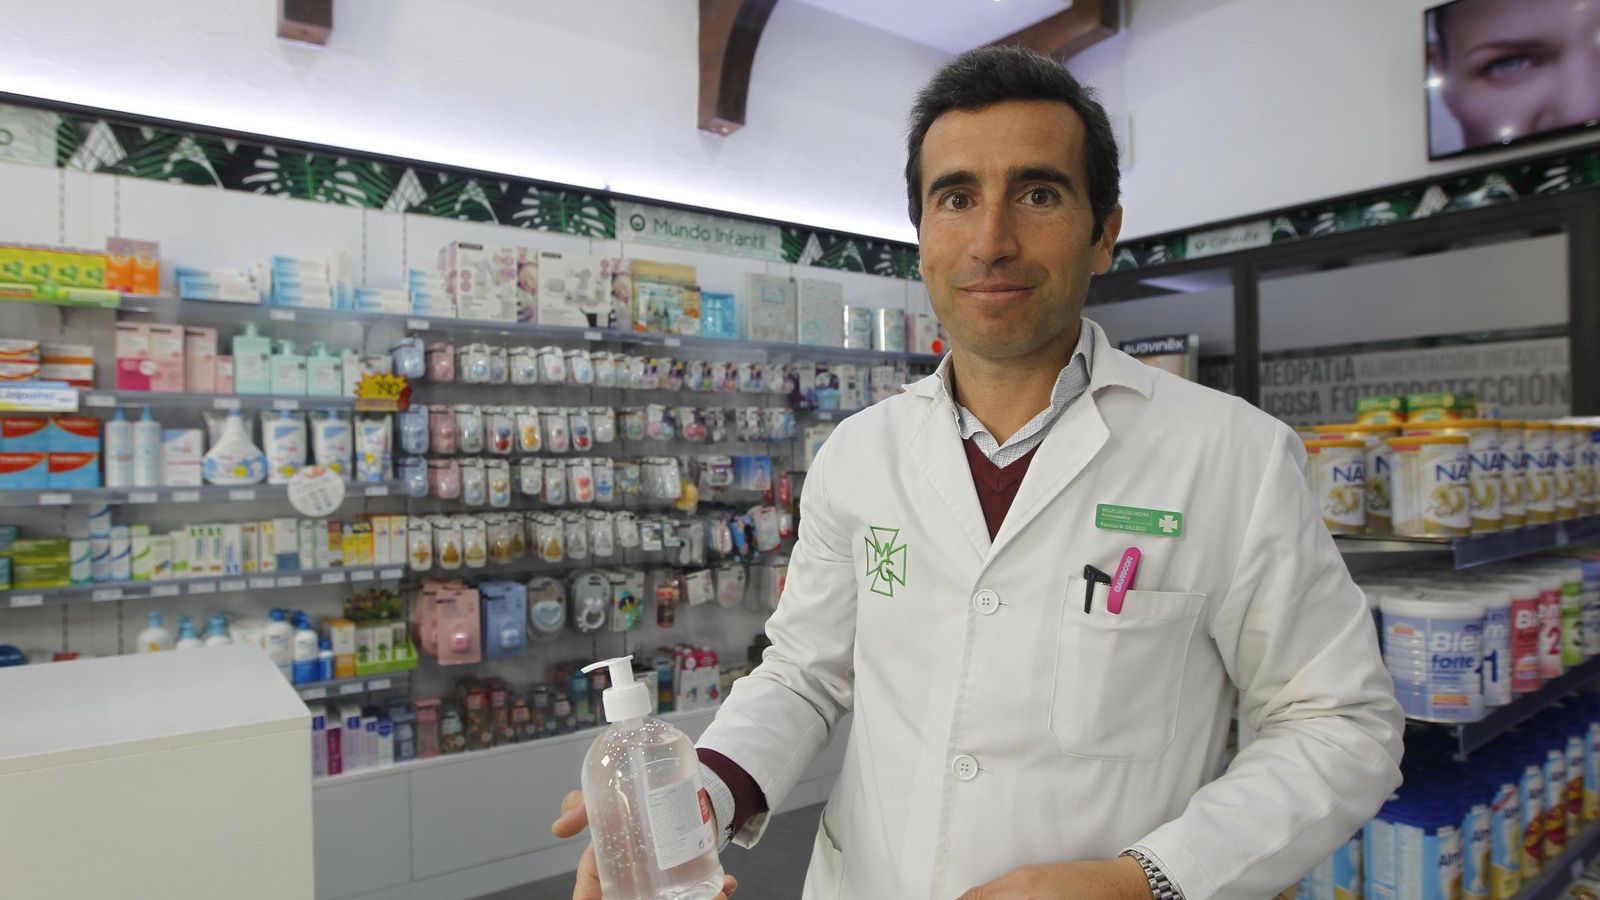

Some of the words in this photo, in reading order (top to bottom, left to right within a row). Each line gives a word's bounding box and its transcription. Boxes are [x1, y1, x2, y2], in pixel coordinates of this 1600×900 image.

[654, 218, 711, 241] Mundo
[715, 227, 766, 249] Infantil
[1112, 555, 1134, 593] GAVISCON
[1431, 630, 1481, 653] Ble
[1432, 653, 1475, 669] forte
